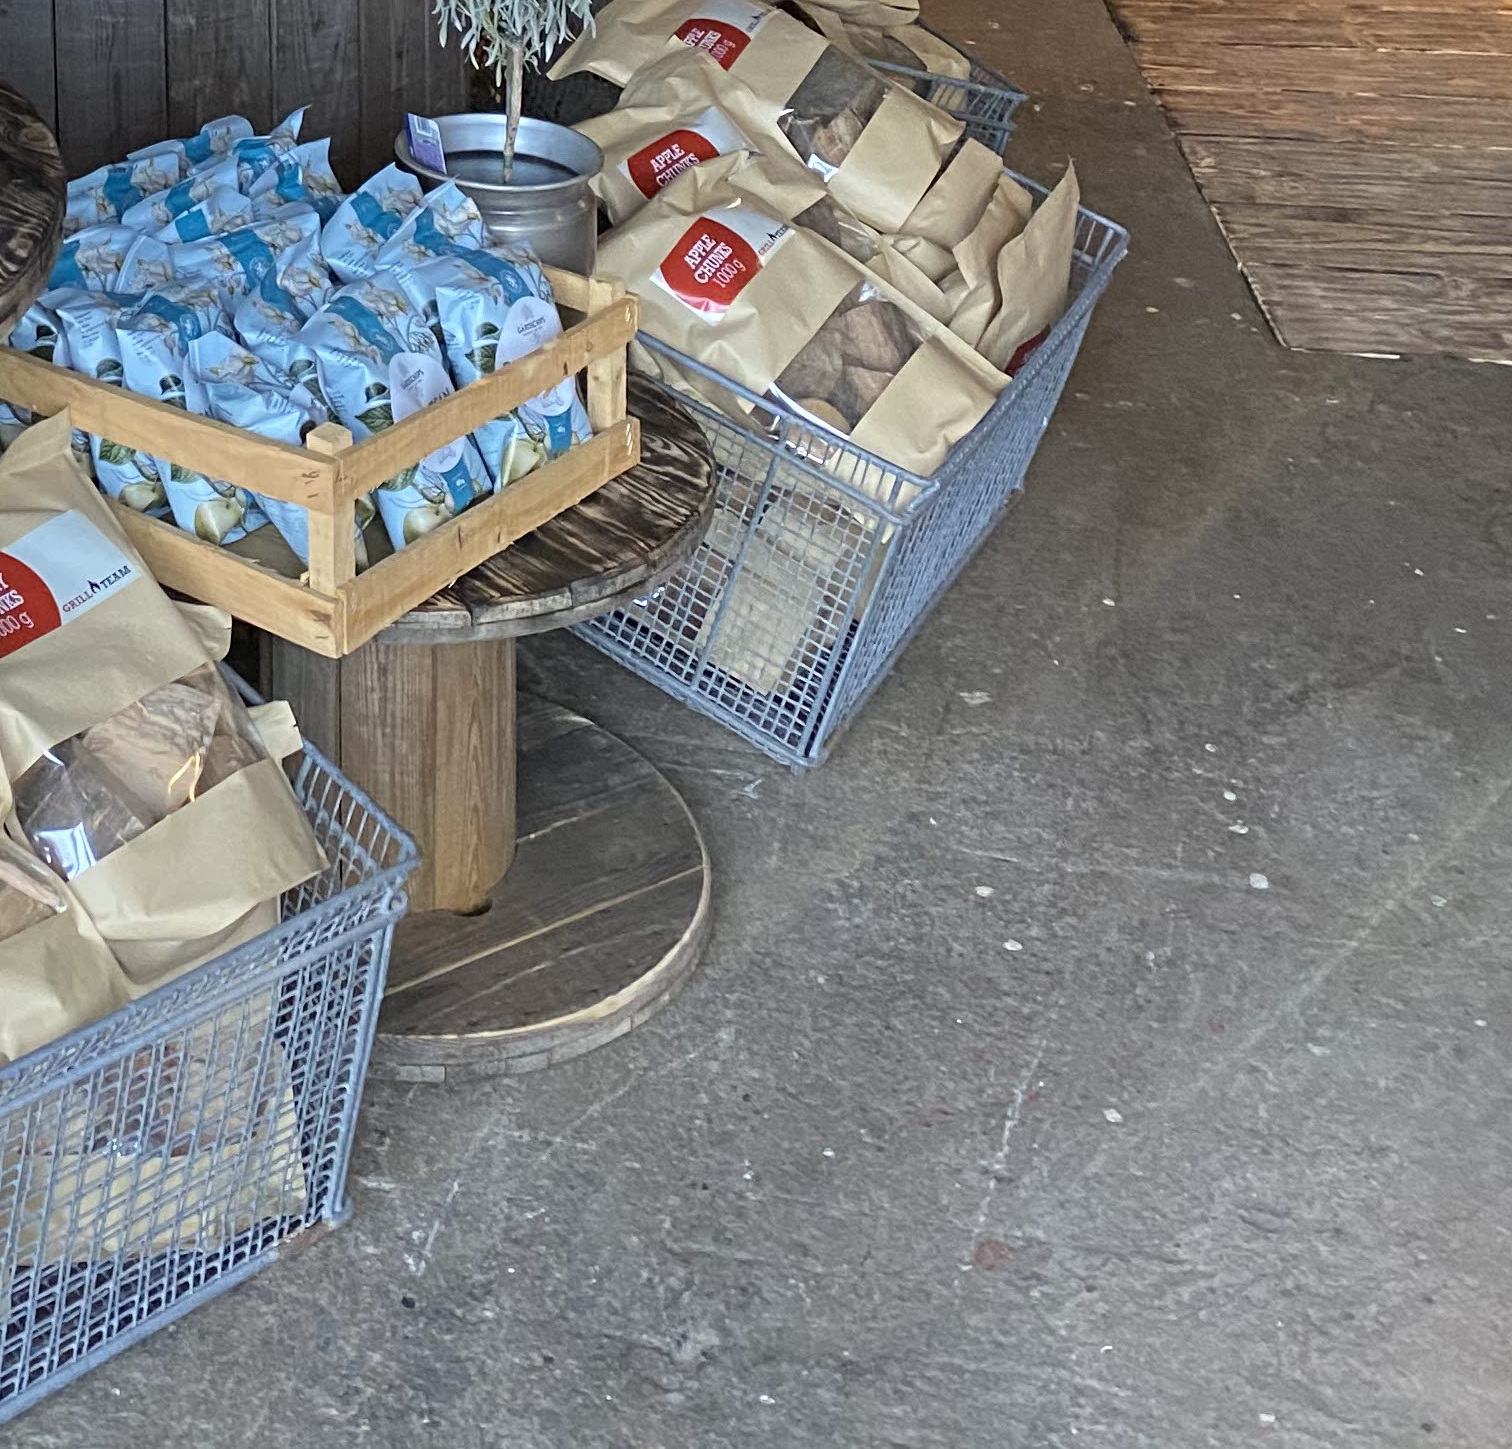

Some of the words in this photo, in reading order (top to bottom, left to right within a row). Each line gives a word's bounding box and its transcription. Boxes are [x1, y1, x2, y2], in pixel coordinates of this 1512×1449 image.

[650, 142, 686, 173] APPLE
[684, 234, 717, 270] APPLE
[693, 241, 733, 284] CHUNKS
[712, 262, 739, 289] 1000
[736, 258, 747, 272] g
[62, 590, 94, 613] GRILL
[99, 564, 132, 590] TEAM
[21, 611, 35, 630] g
